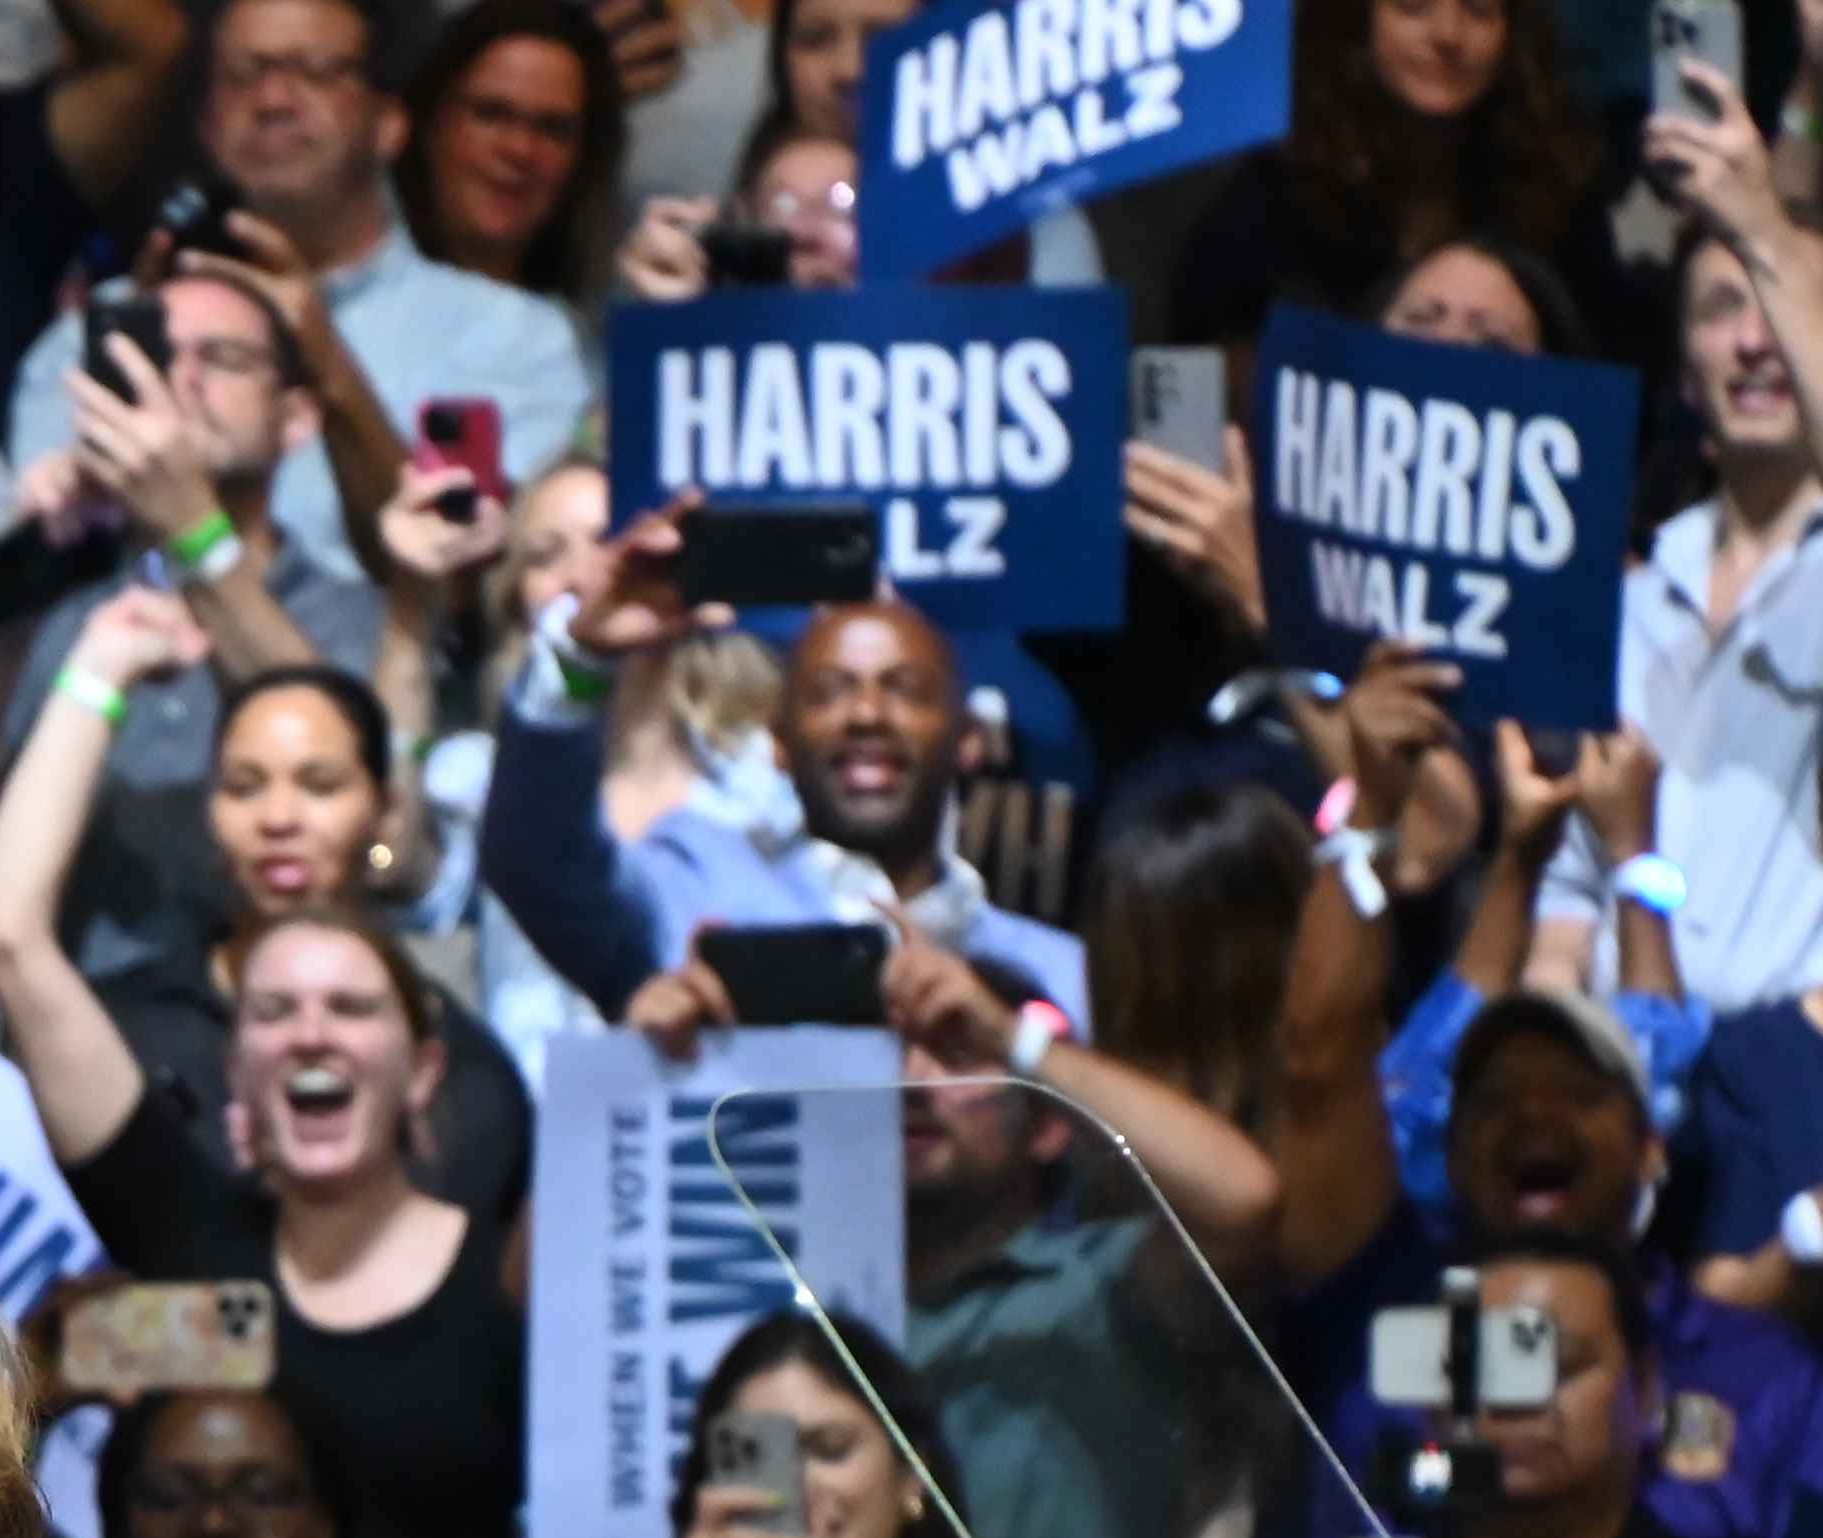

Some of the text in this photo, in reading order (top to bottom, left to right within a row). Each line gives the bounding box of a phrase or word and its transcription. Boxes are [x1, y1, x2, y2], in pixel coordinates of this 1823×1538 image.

[945, 62, 1183, 212] WALZ
[657, 337, 1072, 490] HARRIS
[1275, 364, 1582, 572] HARRIS
[883, 497, 1007, 579] LZ
[1311, 537, 1510, 661] WALZ
[610, 1104, 654, 1510] WHEN WE VOTE
